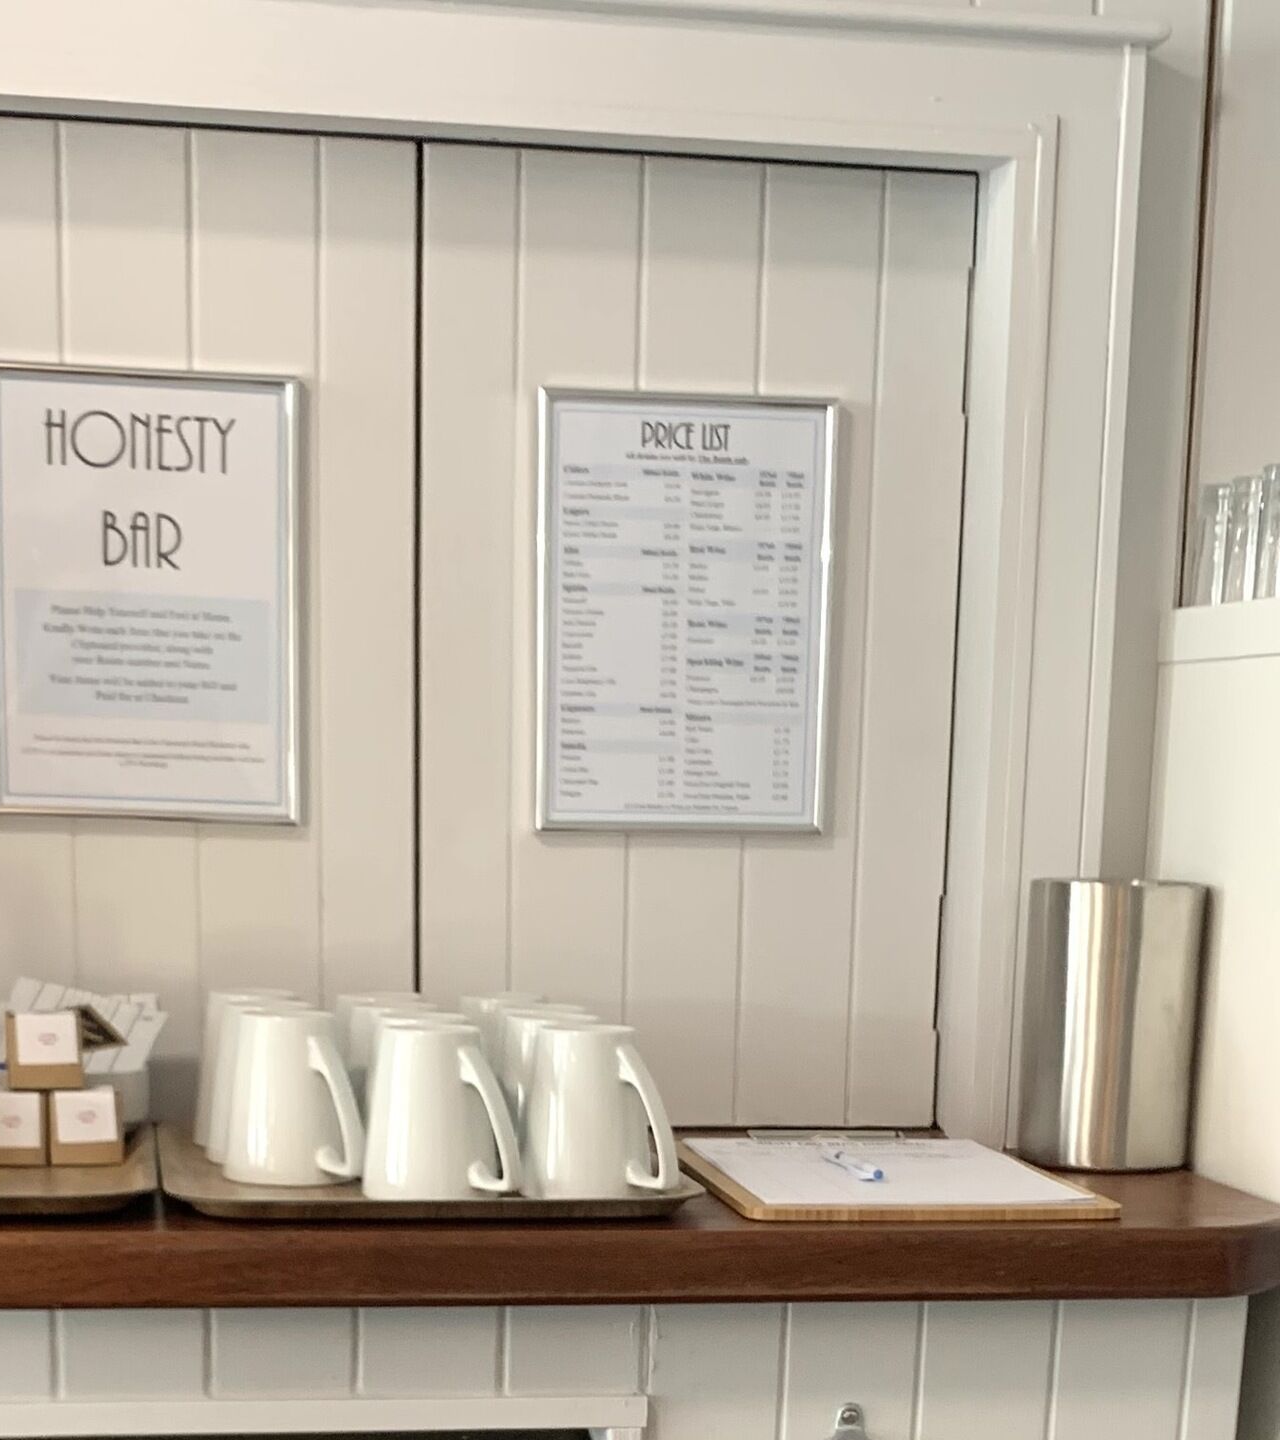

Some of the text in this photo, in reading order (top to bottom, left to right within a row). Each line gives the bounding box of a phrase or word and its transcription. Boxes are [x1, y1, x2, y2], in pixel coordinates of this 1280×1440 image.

[42, 408, 236, 475] HONESTY
[641, 420, 731, 451] PRICE LIST
[101, 510, 183, 571] BAR
